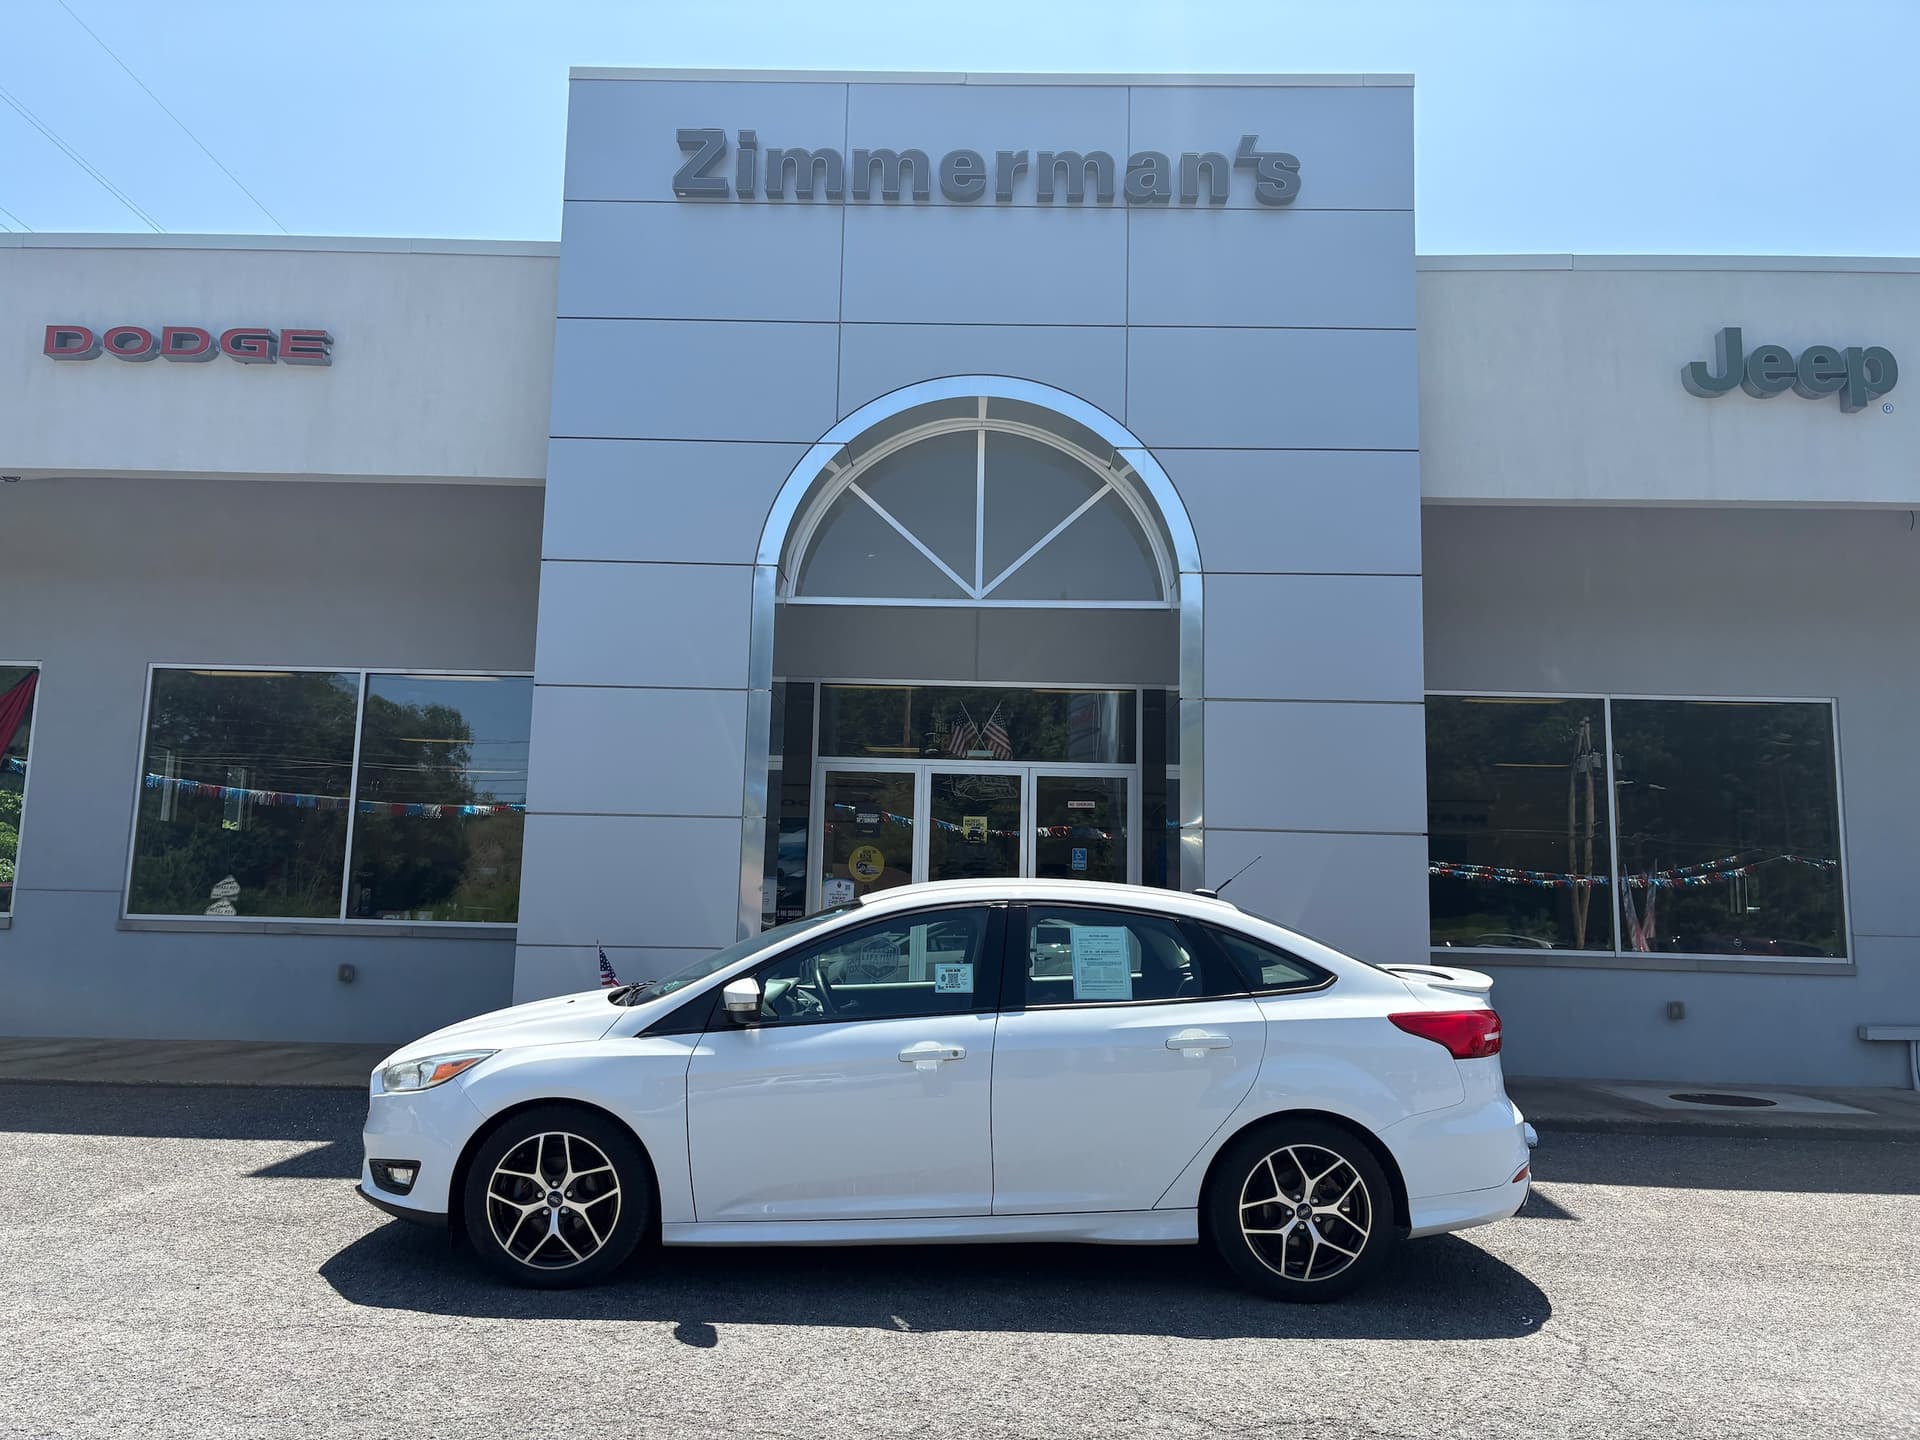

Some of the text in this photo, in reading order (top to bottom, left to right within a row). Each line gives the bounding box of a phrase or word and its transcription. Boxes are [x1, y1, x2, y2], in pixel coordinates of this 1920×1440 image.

[673, 128, 1301, 206] Zimmerman's
[43, 325, 334, 366] DODGE
[1681, 327, 1898, 413] Jeep
